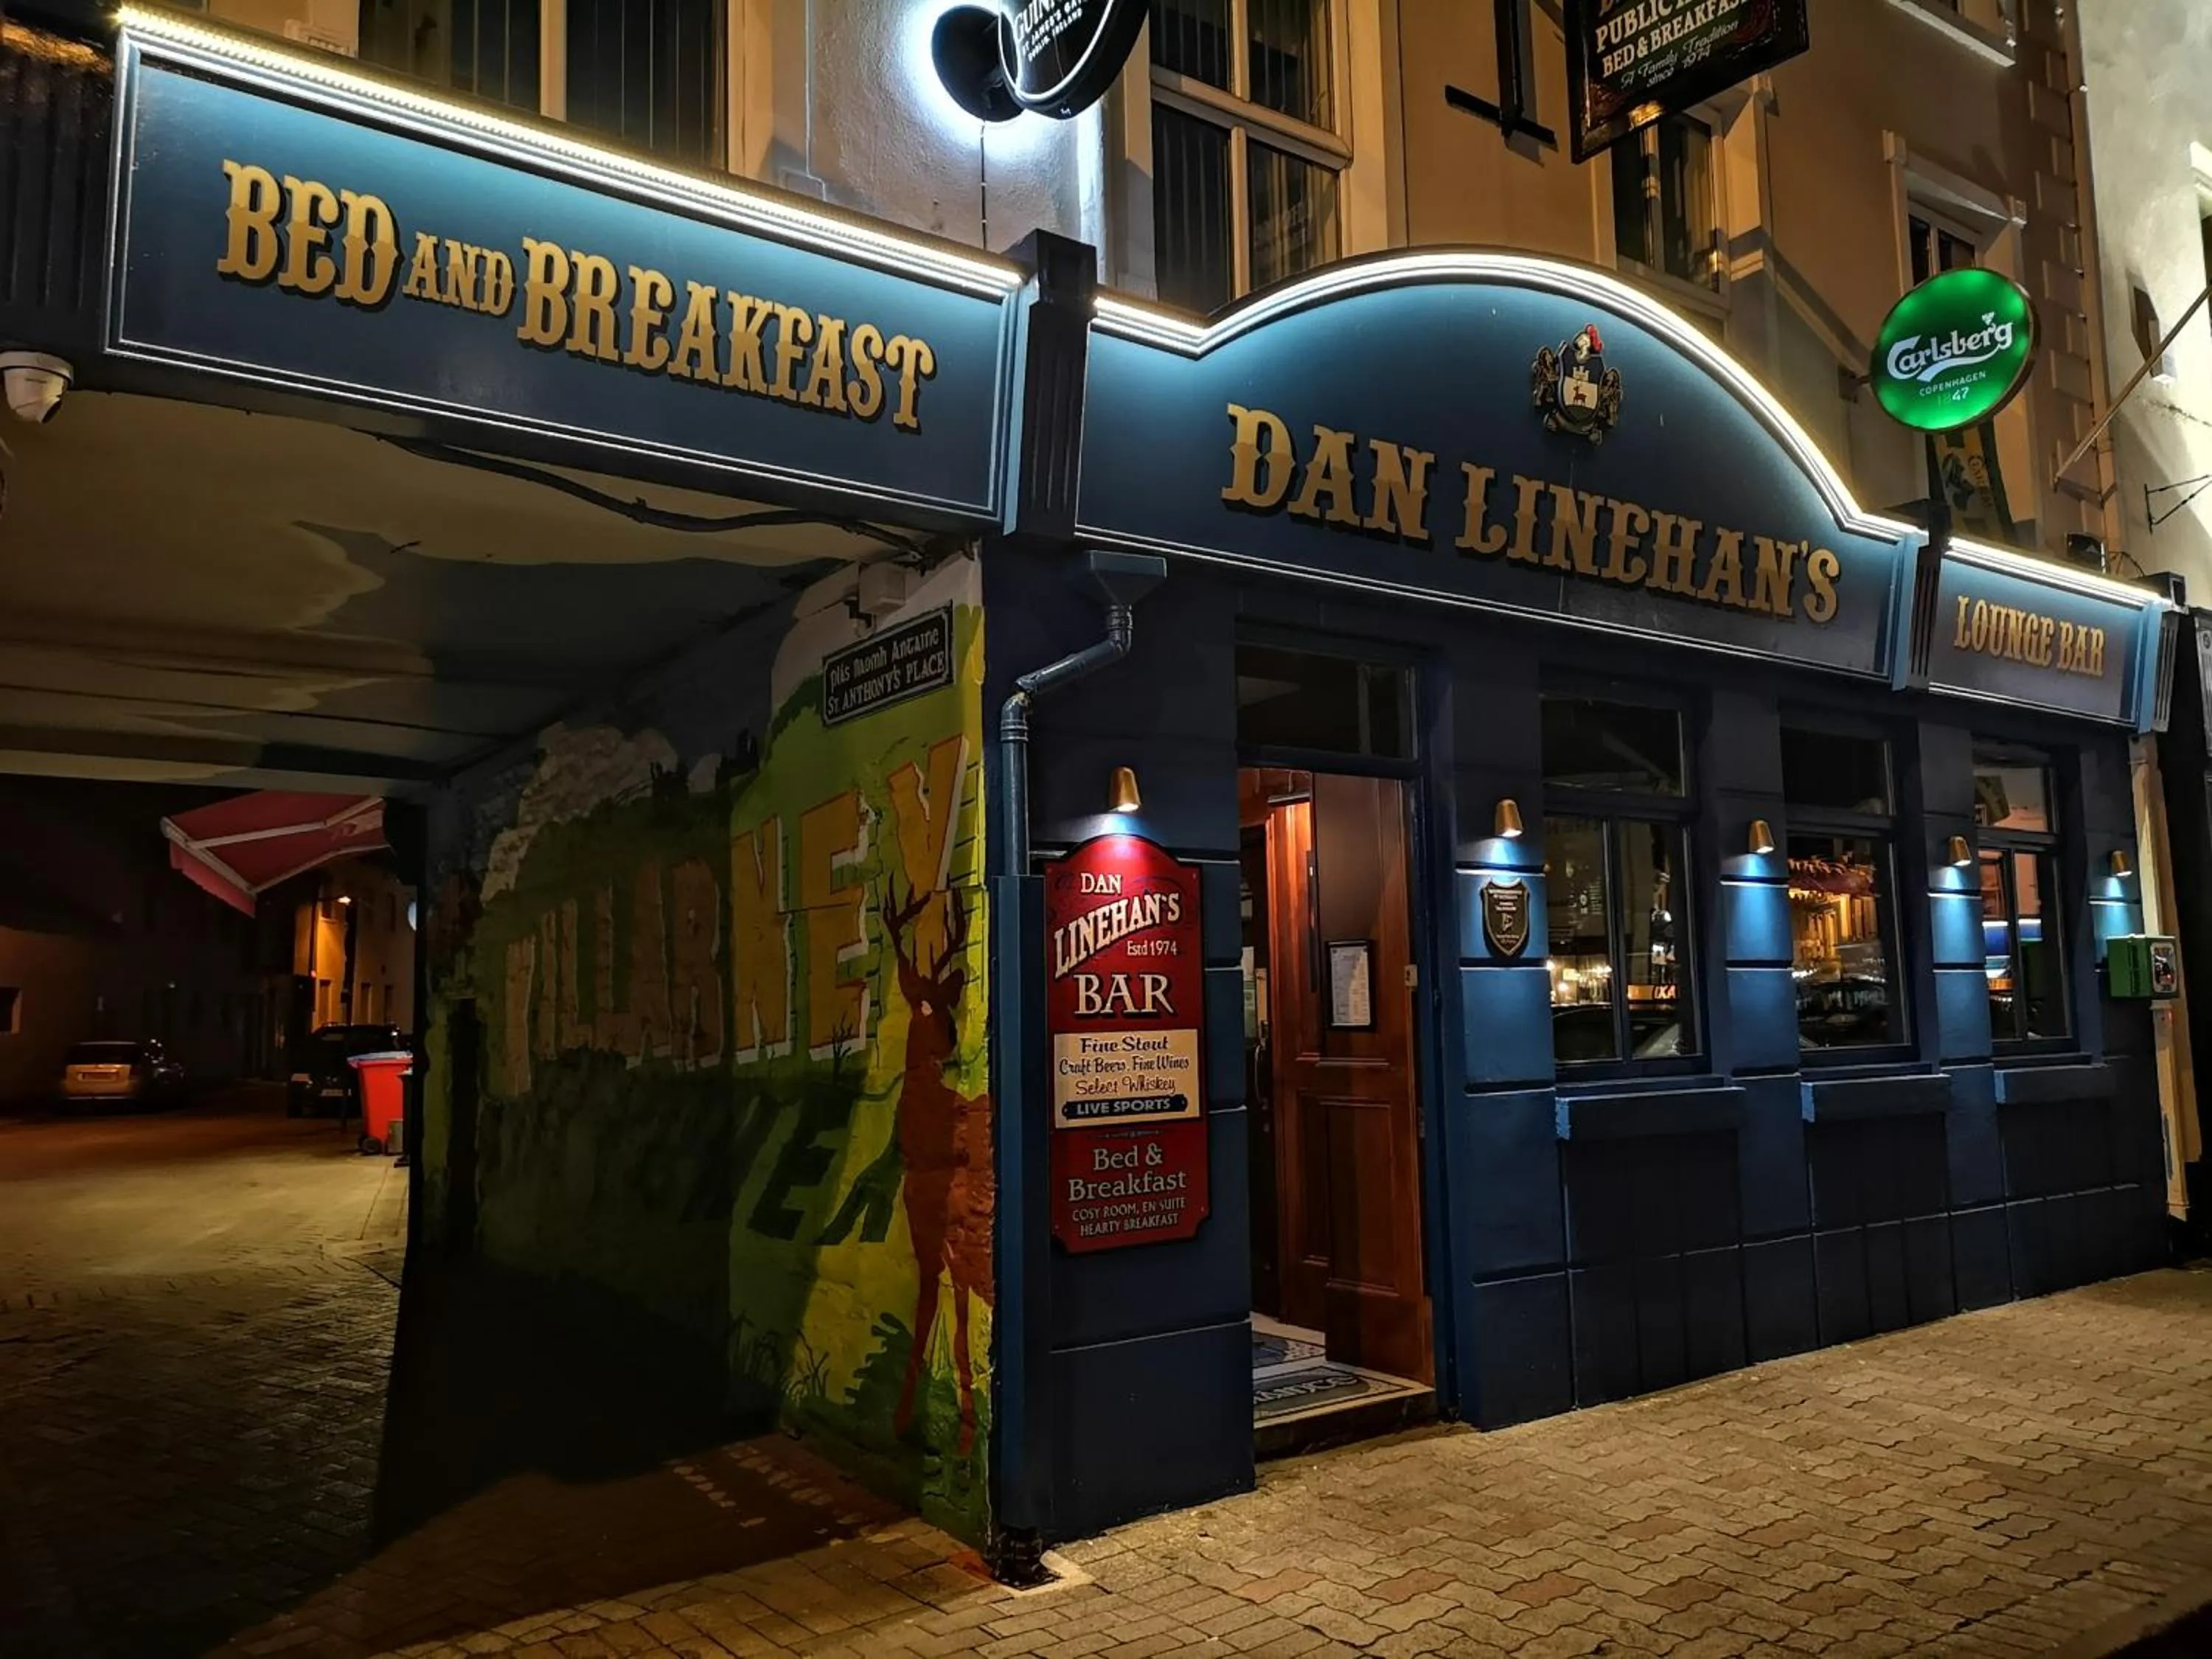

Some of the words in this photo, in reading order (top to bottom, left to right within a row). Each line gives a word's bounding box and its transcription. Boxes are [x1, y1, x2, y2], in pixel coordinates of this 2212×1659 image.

[1595, 0, 1672, 54] PUBLIC
[1602, 44, 1635, 78] BED
[1637, 36, 1649, 58] &
[1638, 49, 1678, 77] Family
[1683, 20, 1739, 53] Tradition
[218, 159, 400, 307] BED
[402, 230, 515, 318] AND
[517, 237, 936, 430] BREAKFAST
[1887, 320, 2014, 381] Carlsberg
[1919, 371, 1986, 397] COPENHAGEN
[1221, 403, 1436, 541] DAN
[1455, 462, 1841, 623] LINEHAN'S
[1954, 595, 2054, 667] LOUNGE
[2057, 622, 2106, 677] BAR
[905, 650, 945, 685] PLACE
[1080, 873, 1121, 894] DAN
[1054, 893, 1180, 978] LINEHAN'S
[1150, 940, 1177, 956] 1974
[1074, 974, 1174, 1015] BAR
[1080, 1037, 1118, 1054] Fine
[1121, 1036, 1169, 1051] Stout
[1060, 1058, 1091, 1075] Craft
[1132, 1055, 1155, 1071] Fine
[1157, 1055, 1189, 1069] Wines
[1076, 1078, 1118, 1095] Select
[1121, 1074, 1175, 1094] Whiskey
[1077, 1102, 1110, 1116] LIVE
[1113, 1097, 1172, 1113] SPORTS
[1092, 1144, 1139, 1172] Bed
[1145, 1142, 1164, 1166] &
[1068, 1171, 1186, 1203] Breakfast
[1072, 1207, 1101, 1222] COSY
[1143, 1200, 1156, 1214] EN
[1159, 1197, 1187, 1211] SUITE
[1079, 1220, 1121, 1237] HEARTY
[1123, 1213, 1179, 1231] BREAKFAST
